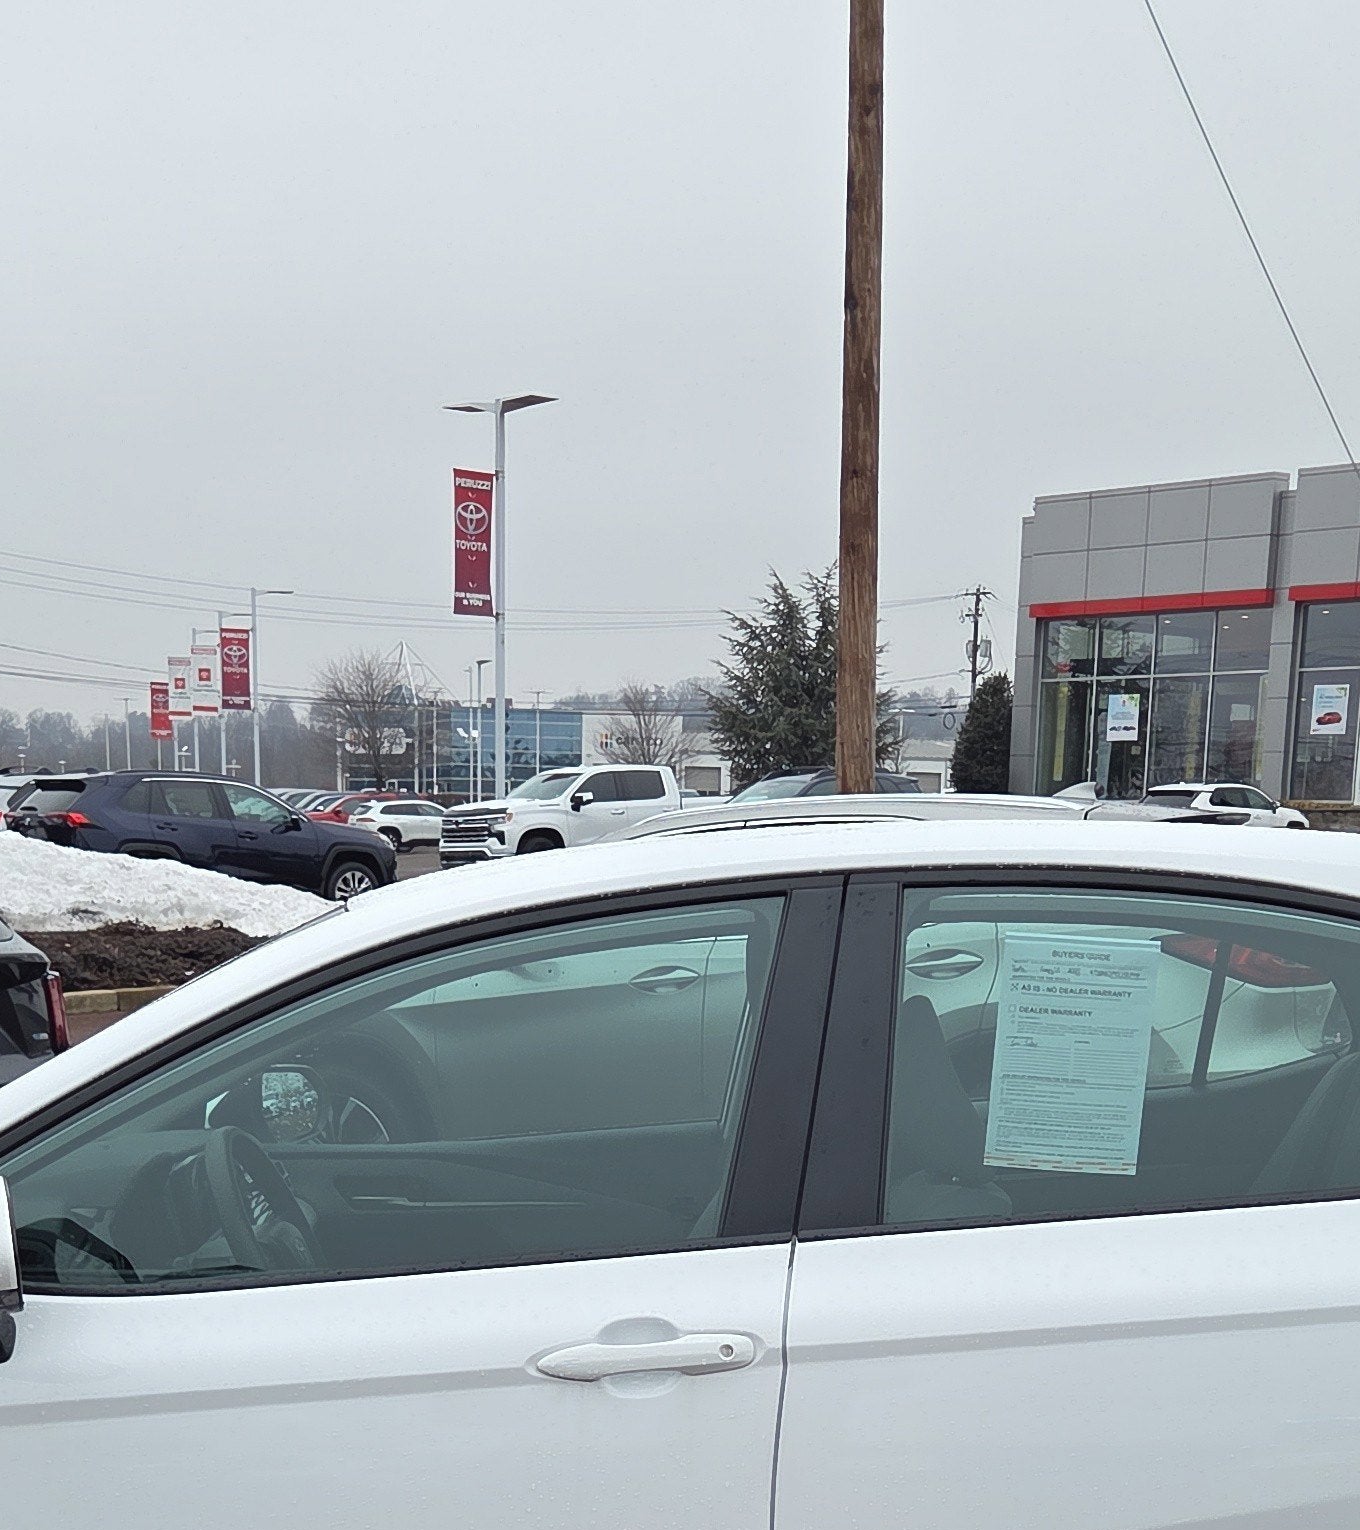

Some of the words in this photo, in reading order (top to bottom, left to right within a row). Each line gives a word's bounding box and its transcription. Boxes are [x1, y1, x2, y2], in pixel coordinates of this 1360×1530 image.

[455, 477, 491, 490] PERUZZI
[455, 540, 488, 552] TOYOTA
[1046, 986, 1058, 994] NO
[1058, 986, 1089, 996] DEALER
[1090, 989, 1133, 999] WARRANTY
[1018, 1005, 1049, 1015] DEALER
[1050, 1008, 1094, 1018] WARRANTY
